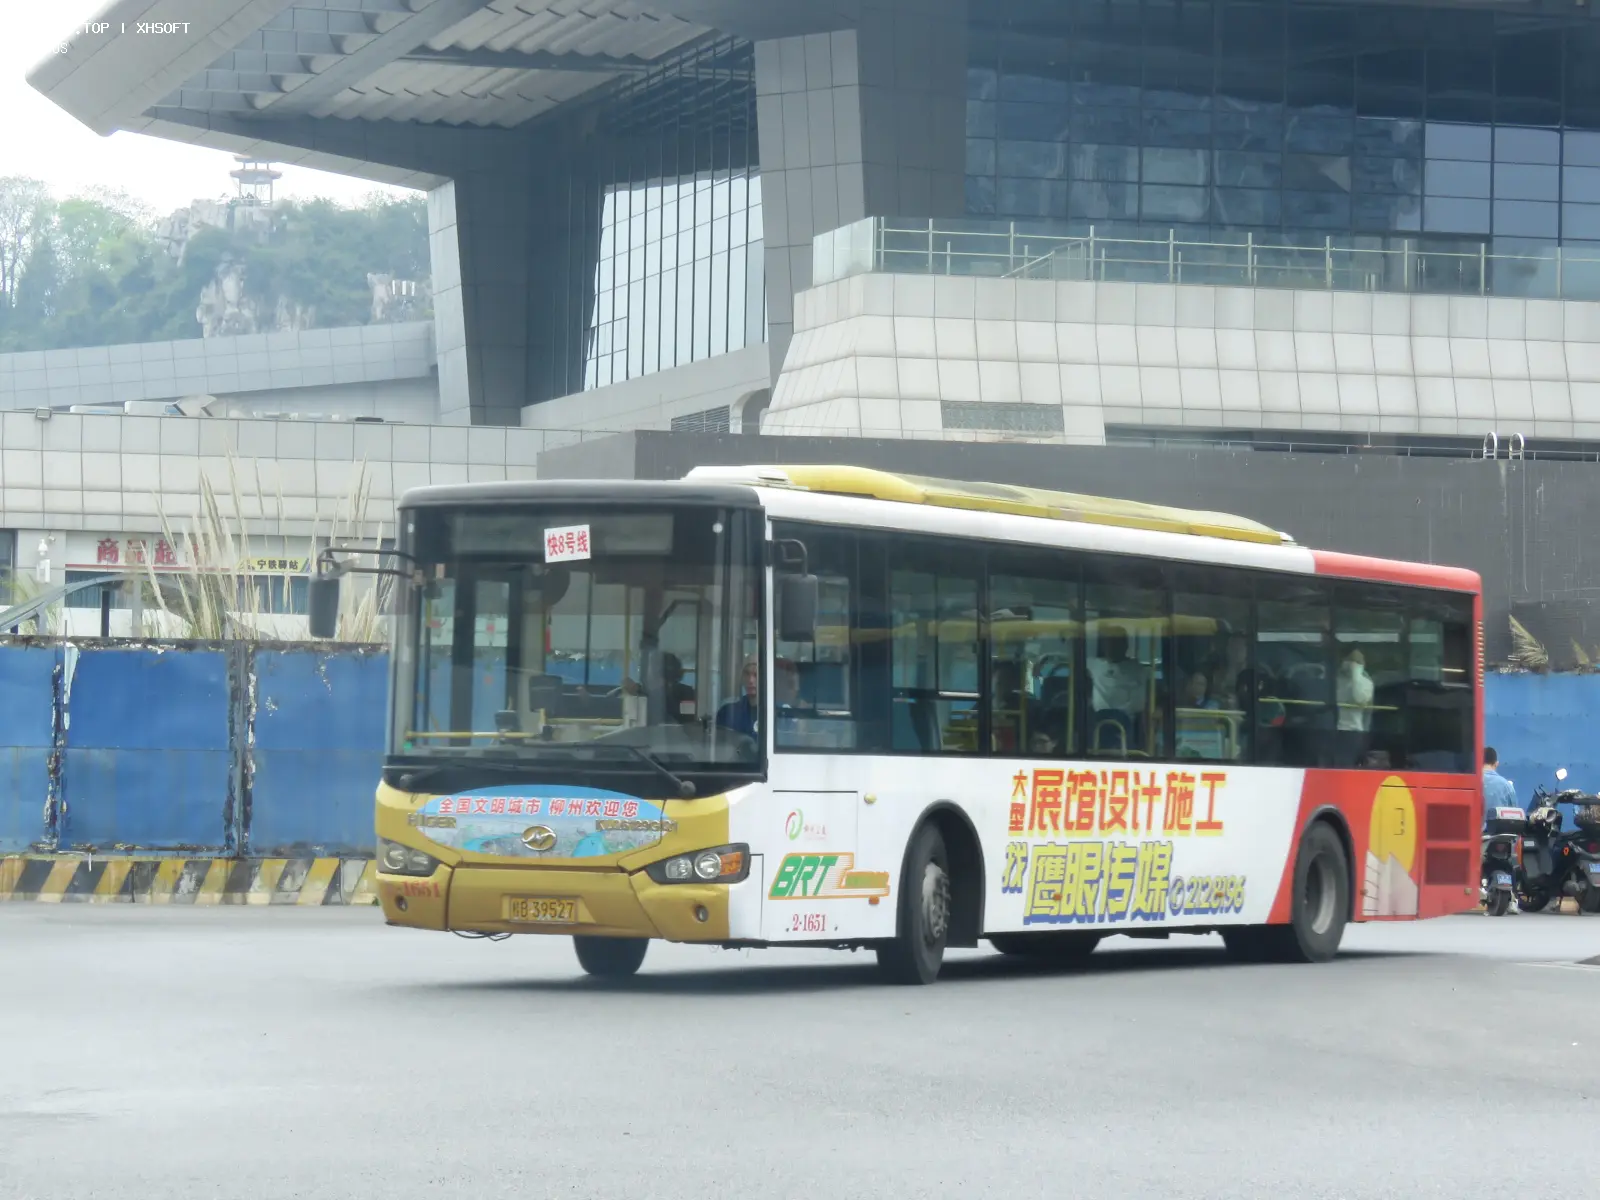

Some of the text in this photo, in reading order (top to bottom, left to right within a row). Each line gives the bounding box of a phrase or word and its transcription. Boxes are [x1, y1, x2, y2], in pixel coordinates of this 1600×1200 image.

[547, 530, 588, 556] 快8号线
[439, 797, 639, 818] 全国文明城市 柳州欢迎您
[1028, 769, 1227, 834] 展馆设计施工
[770, 855, 840, 897] BRT
